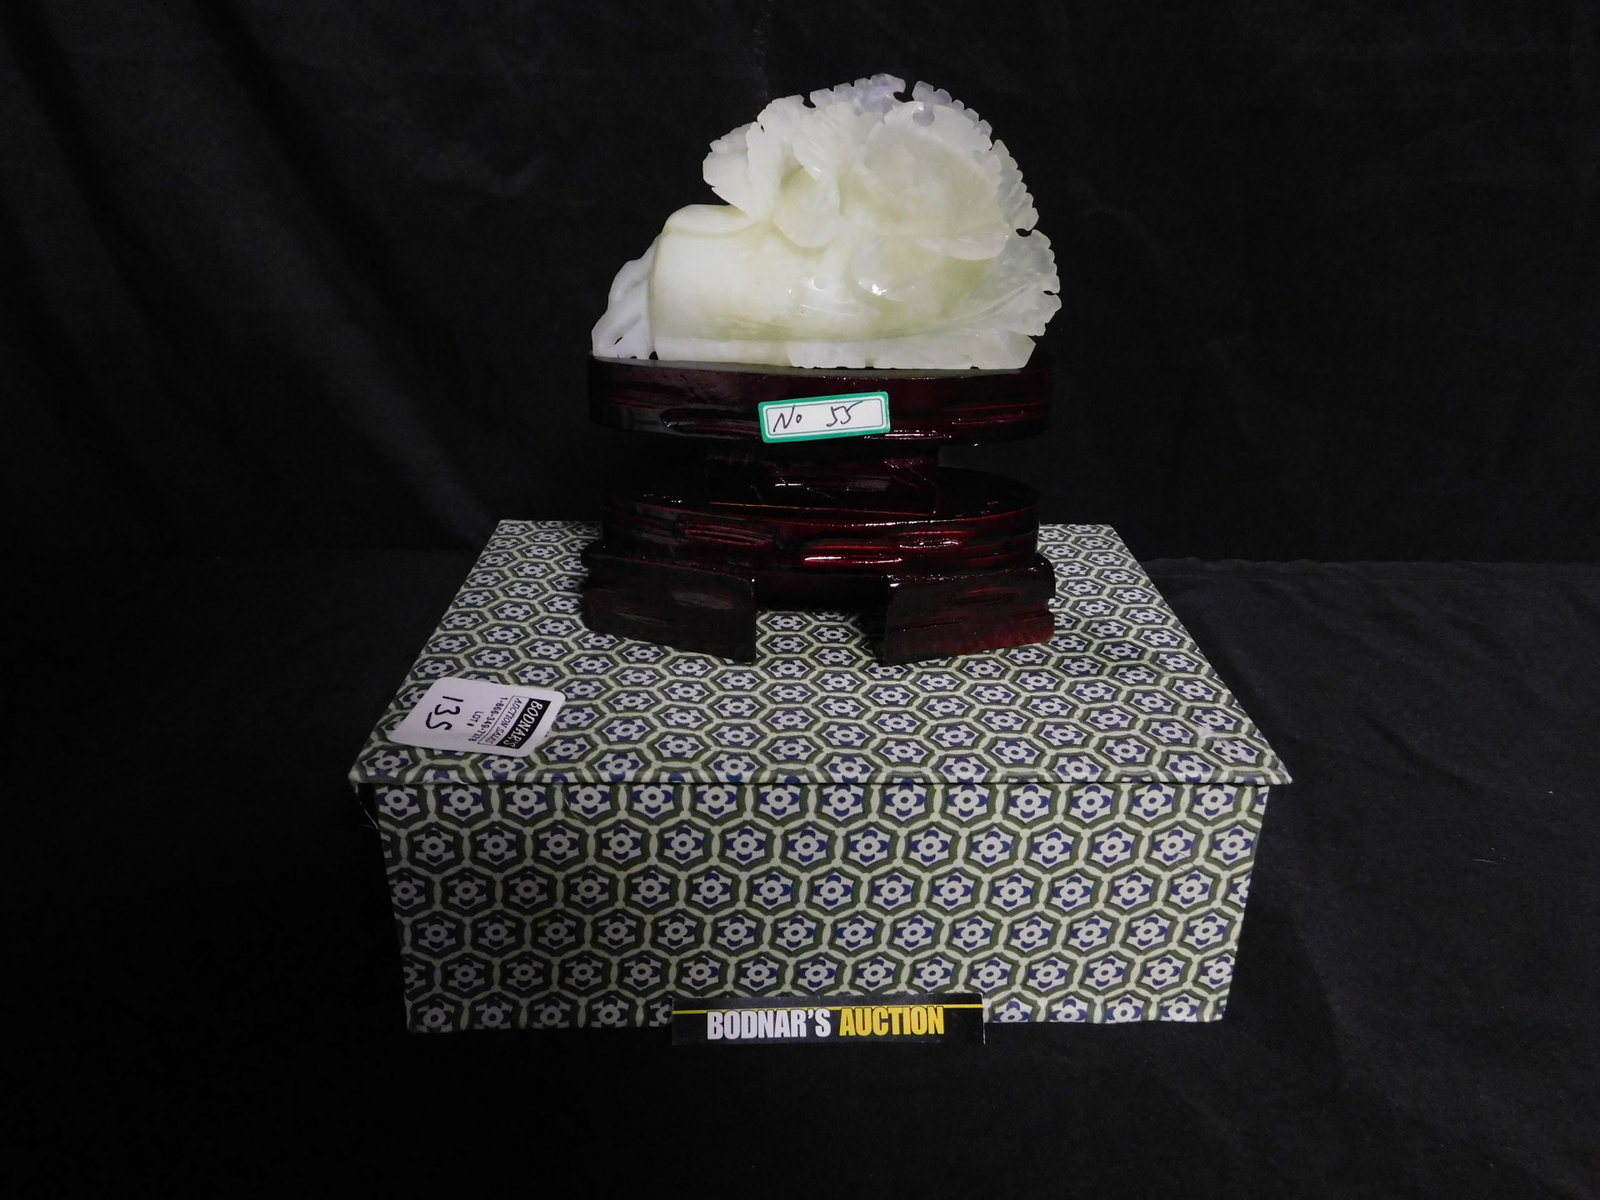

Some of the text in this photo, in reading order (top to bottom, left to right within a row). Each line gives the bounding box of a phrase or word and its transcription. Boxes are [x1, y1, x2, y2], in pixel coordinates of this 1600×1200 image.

[470, 710, 484, 723] LOT
[485, 698, 522, 744] AUCTION SALES
[503, 700, 543, 748] BODNAR'S
[706, 1005, 945, 1040] BODNAR'S AUCTION
